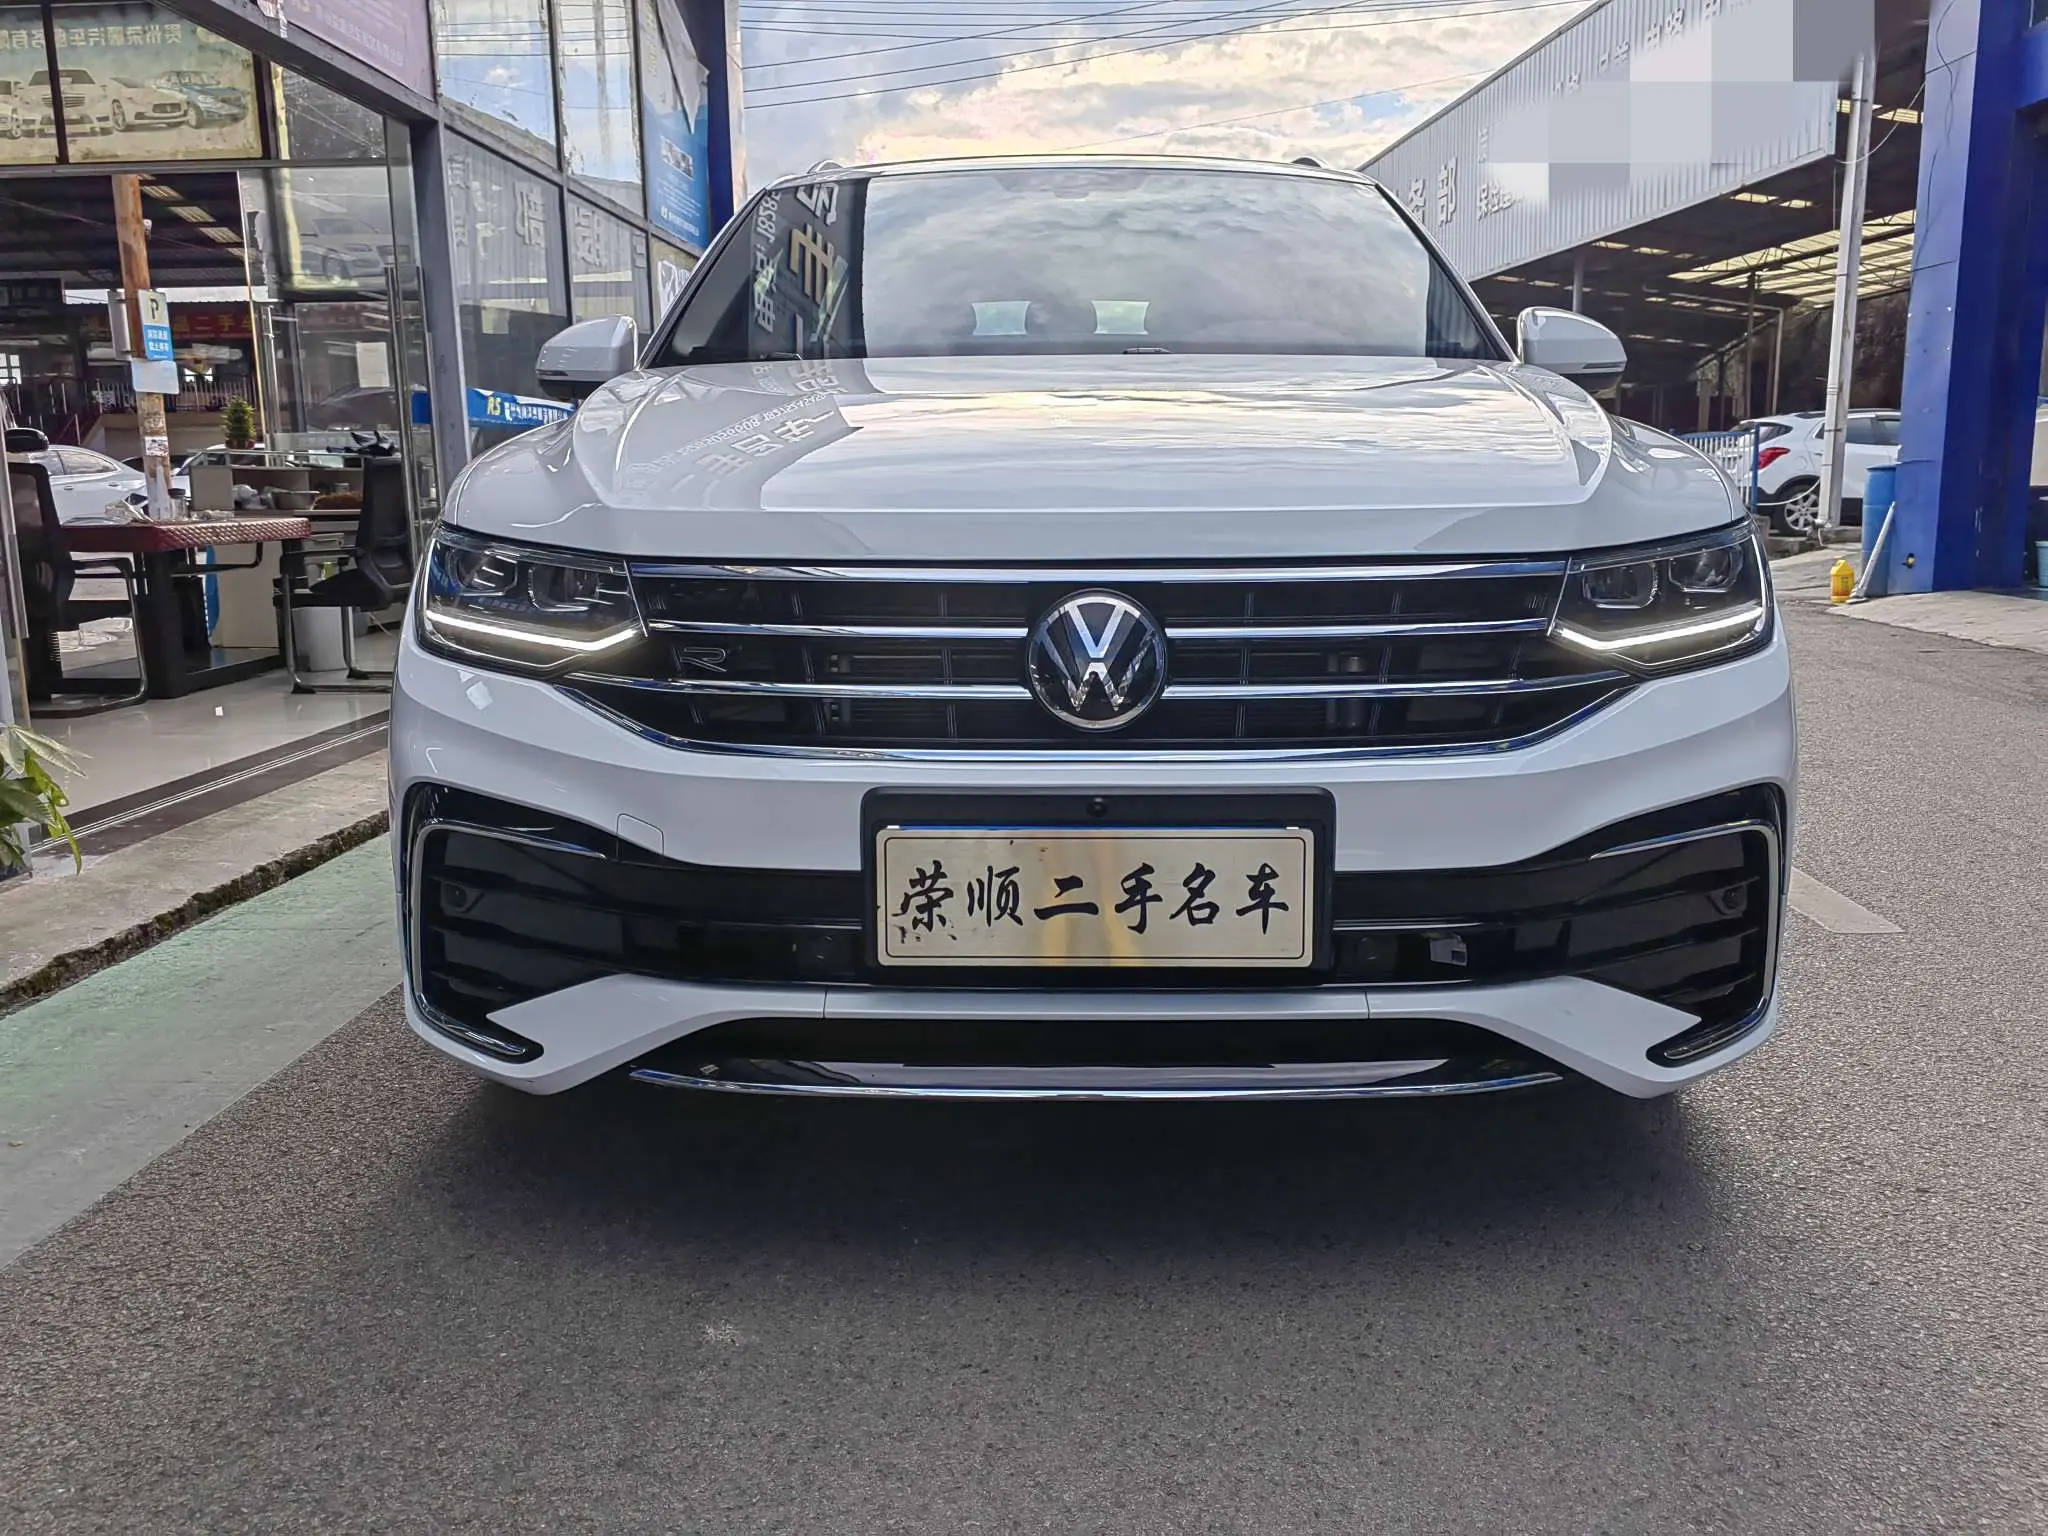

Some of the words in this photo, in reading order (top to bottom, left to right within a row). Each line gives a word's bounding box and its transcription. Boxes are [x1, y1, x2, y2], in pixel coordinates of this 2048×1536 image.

[891, 859, 1289, 936] 荣顺二手名车
